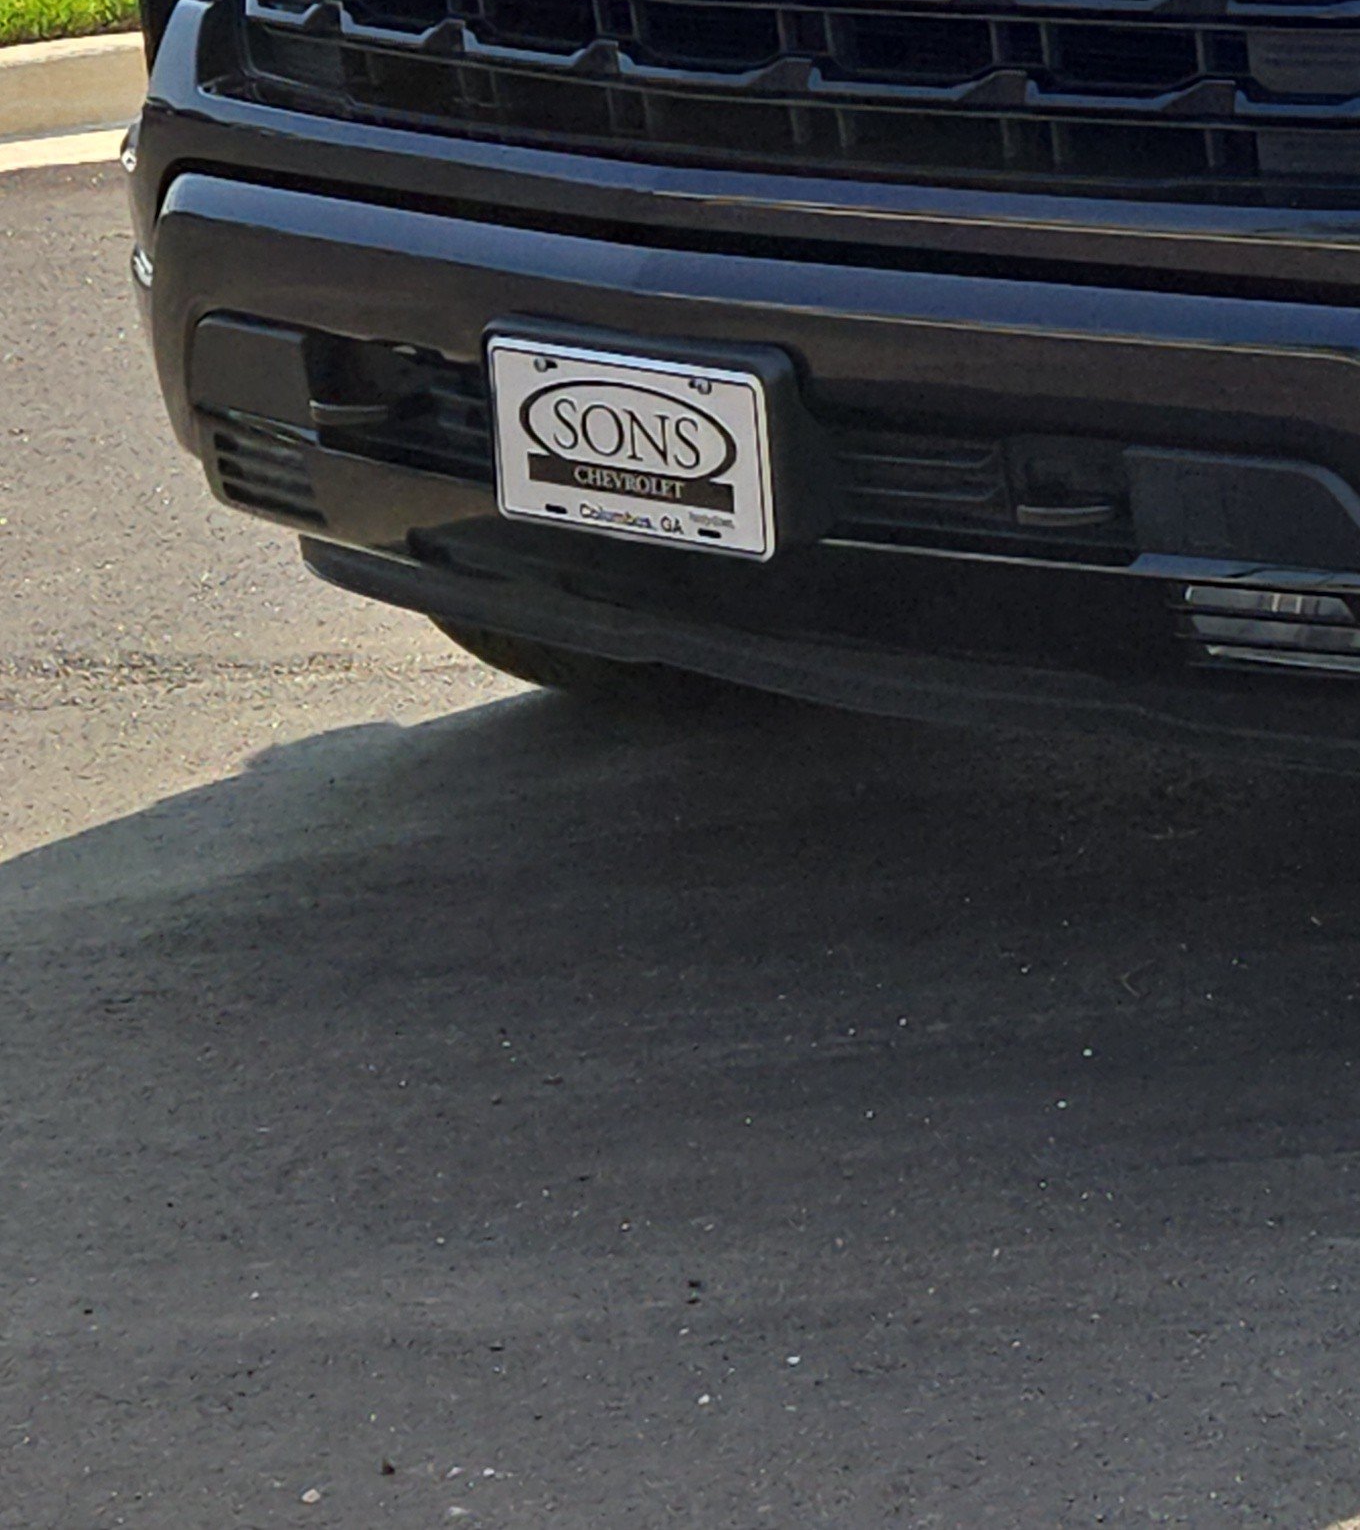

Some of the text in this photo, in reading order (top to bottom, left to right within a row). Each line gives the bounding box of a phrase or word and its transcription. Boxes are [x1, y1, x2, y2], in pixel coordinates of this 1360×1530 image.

[553, 398, 701, 470] SONS
[574, 467, 685, 500] CHEVROLET
[660, 515, 685, 535] GA
